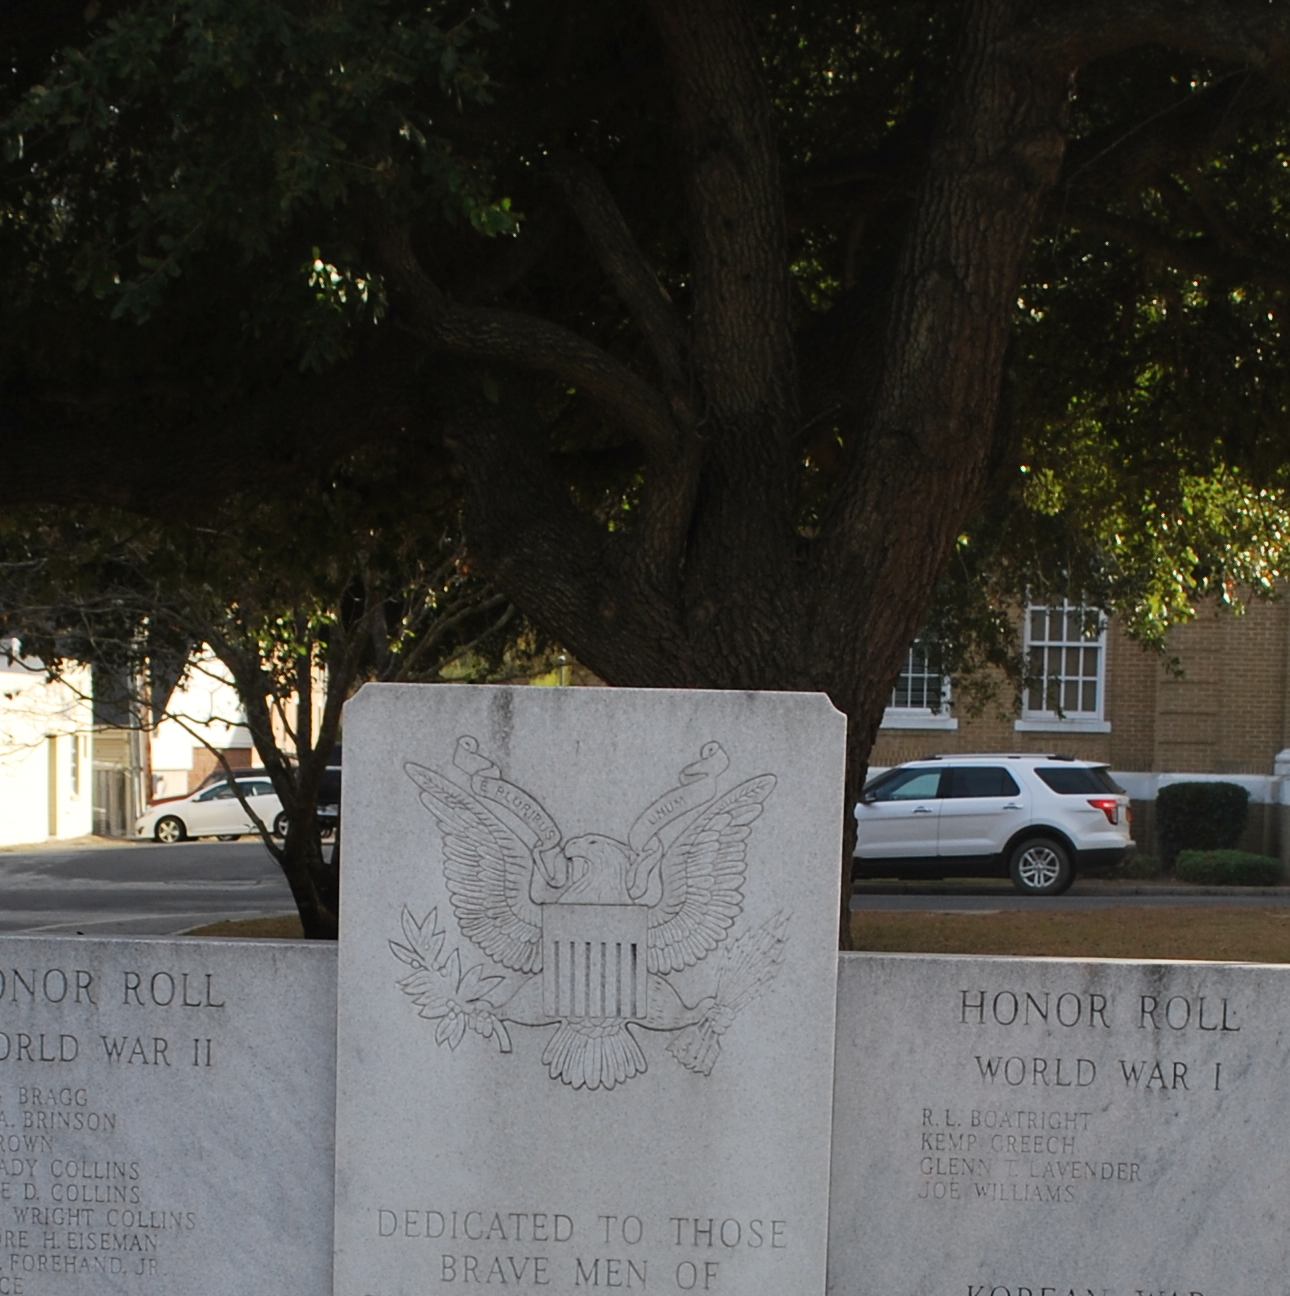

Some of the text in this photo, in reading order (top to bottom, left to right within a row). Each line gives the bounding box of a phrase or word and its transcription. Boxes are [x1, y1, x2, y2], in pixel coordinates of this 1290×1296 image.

[480, 780, 488, 792] E
[123, 971, 225, 1008] ROLL
[959, 989, 1240, 1032] HONOR ROLL
[100, 1036, 169, 1066] WAR
[193, 1039, 212, 1067] II
[975, 1056, 1222, 1090] WORLD WAR I
[19, 1087, 88, 1106] BRAGG
[23, 1111, 116, 1131] BRINSON
[921, 1109, 1093, 1131] R. L. BOATRIGHT
[921, 1134, 977, 1151] KEMP
[51, 1160, 139, 1180] COLLINS
[920, 1158, 1141, 1182] GLENN LAVENDER
[23, 1183, 40, 1201] D.
[51, 1184, 141, 1204] COLLINS
[918, 1181, 1075, 1203] JOE WILLIAMS
[14, 1207, 95, 1226] WRIGHT
[106, 1209, 196, 1230] COLLINS
[377, 1209, 788, 1249] DEDICATED TO THOSE
[43, 1232, 60, 1249] H.
[68, 1233, 157, 1252] EISEMAN
[440, 1254, 720, 1291] BRAVE MEN OF
